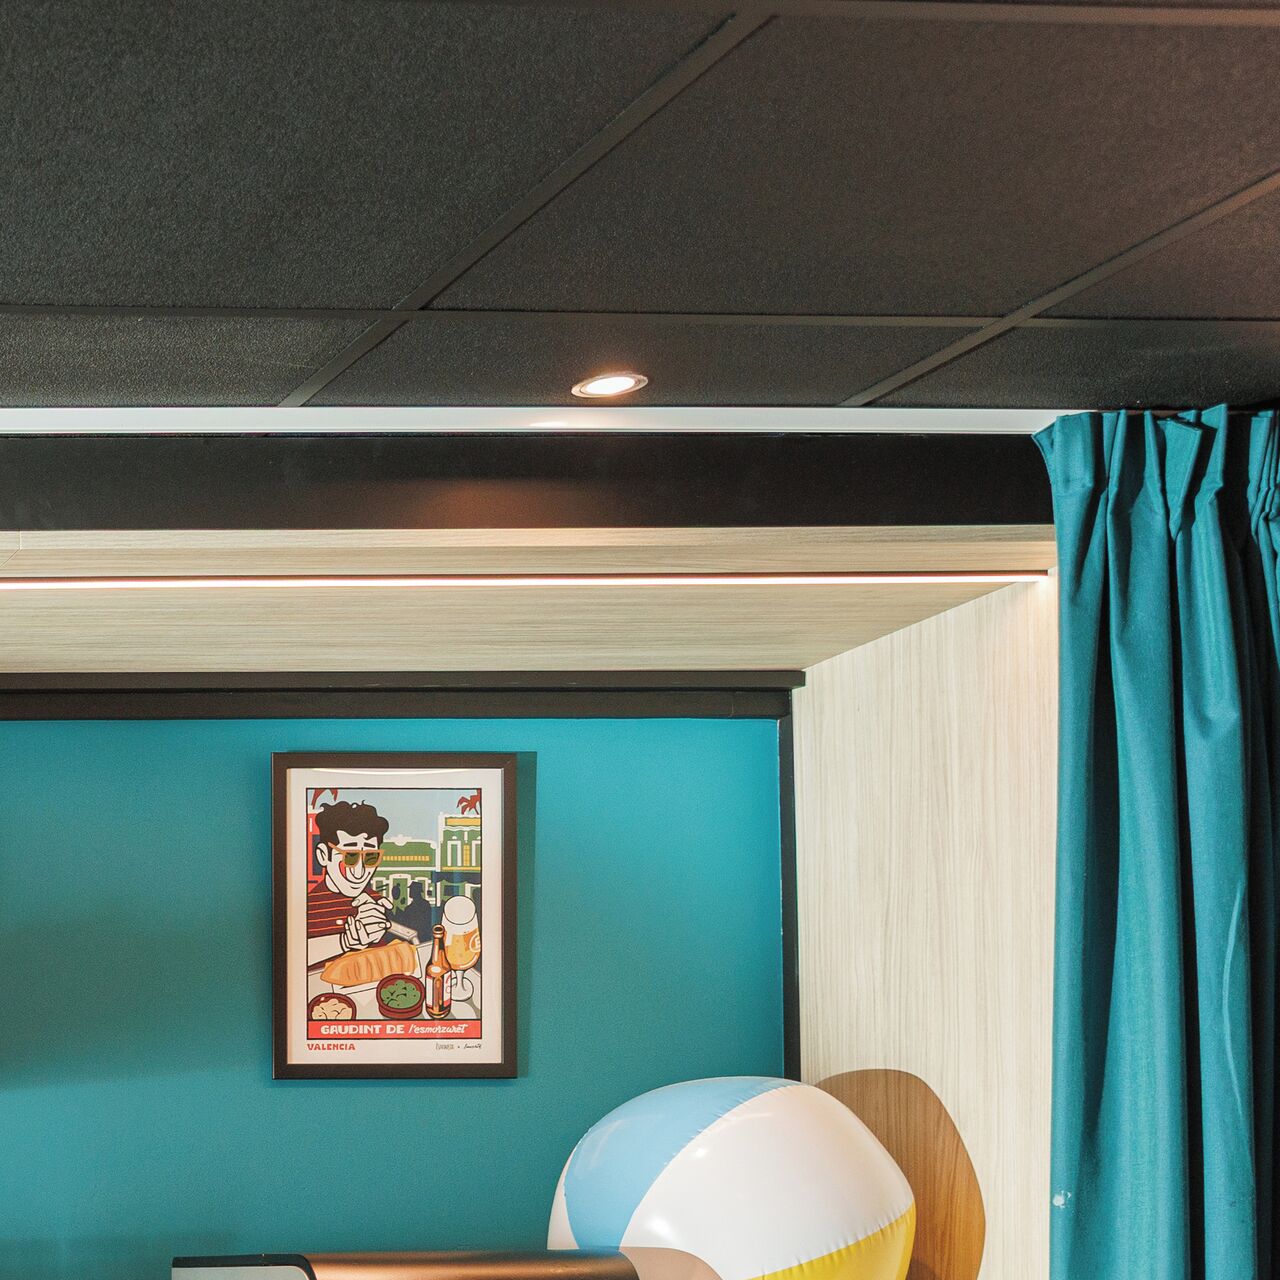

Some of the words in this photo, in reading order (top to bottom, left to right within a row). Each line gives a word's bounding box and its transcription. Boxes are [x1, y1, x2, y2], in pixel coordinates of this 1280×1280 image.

[320, 1024, 382, 1035] GAUDINT
[386, 1024, 405, 1034] DE
[307, 1043, 356, 1051] VALENCIA
